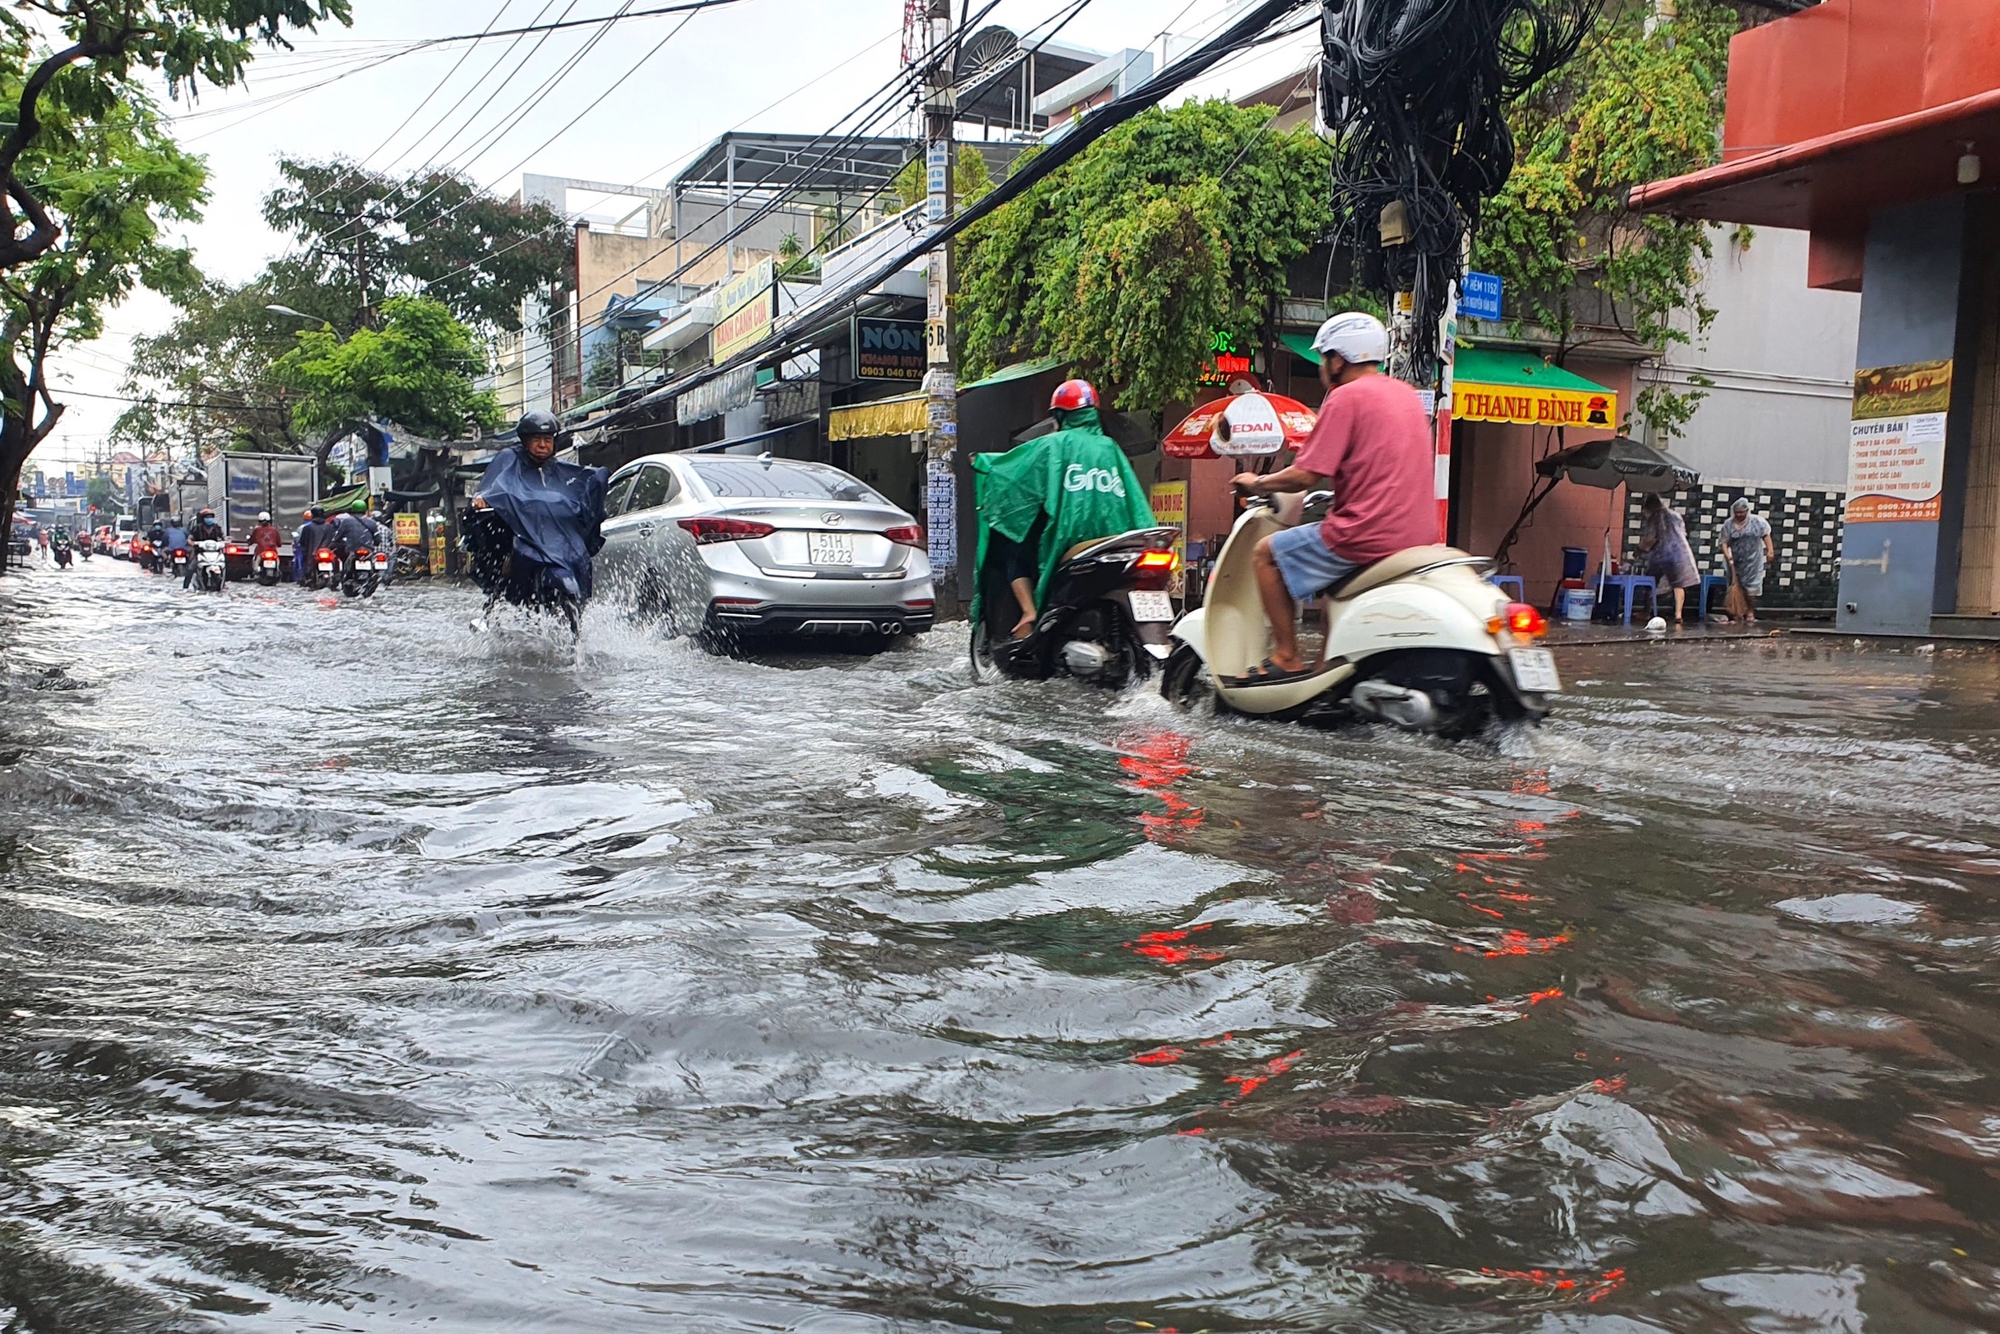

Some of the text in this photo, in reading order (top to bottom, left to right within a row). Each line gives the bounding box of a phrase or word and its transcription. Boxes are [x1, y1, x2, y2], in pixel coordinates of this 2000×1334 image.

[1484, 281, 1497, 295] 1152
[862, 322, 921, 351] NÓN
[861, 353, 924, 367] KHANG HUY
[861, 367, 924, 378] 0903 040 674
[1464, 393, 1532, 419] THANH
[1537, 392, 1584, 422] BÌNH
[1230, 423, 1273, 434] EDAN
[1887, 420, 1904, 432] BÁN
[1063, 463, 1126, 498] Grab
[819, 534, 844, 549] 51H
